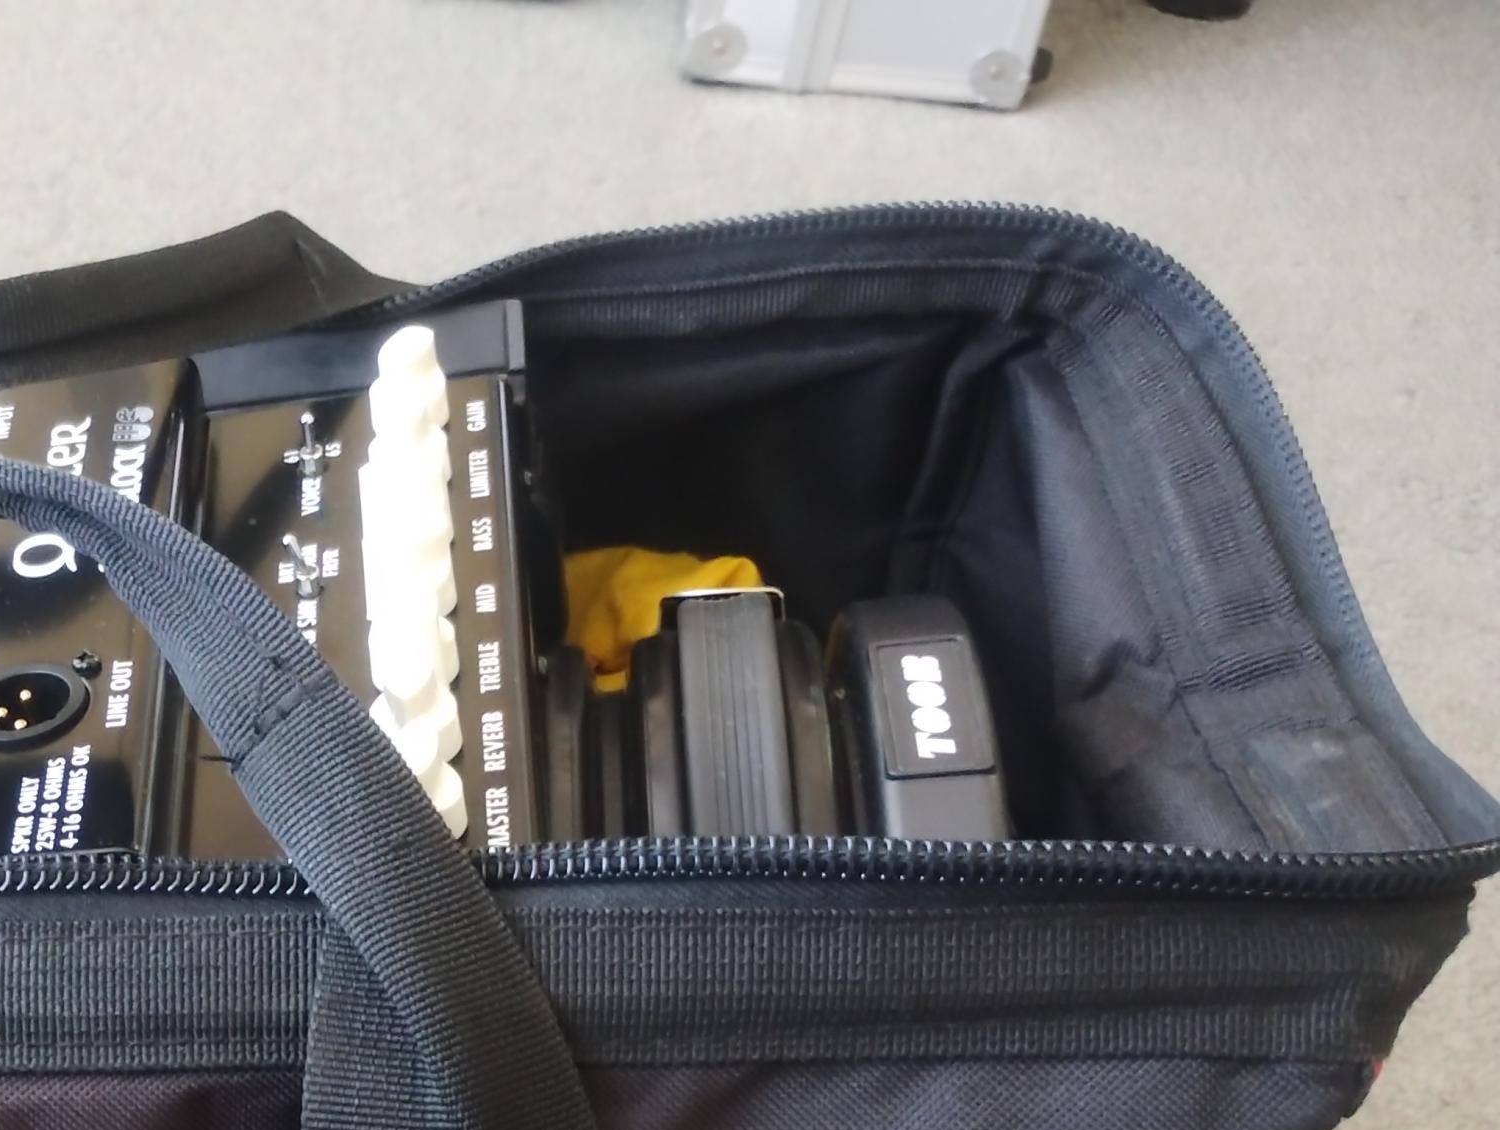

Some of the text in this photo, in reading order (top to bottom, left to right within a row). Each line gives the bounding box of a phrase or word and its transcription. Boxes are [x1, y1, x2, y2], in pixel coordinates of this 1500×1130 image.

[466, 400, 486, 432] GAIN
[469, 450, 490, 498] LIMITER
[472, 517, 493, 551] BASS
[475, 584, 497, 613] MID
[105, 660, 133, 728] LINE OUT
[478, 641, 501, 694] TREBLE
[901, 655, 956, 758] TOOB
[482, 711, 506, 772] REVERB
[11, 777, 40, 854] SPKR ONLY
[35, 757, 66, 850] 25W-8 OHMS
[60, 744, 91, 849] 4-16 OHMS OK
[485, 786, 510, 854] MASTER
